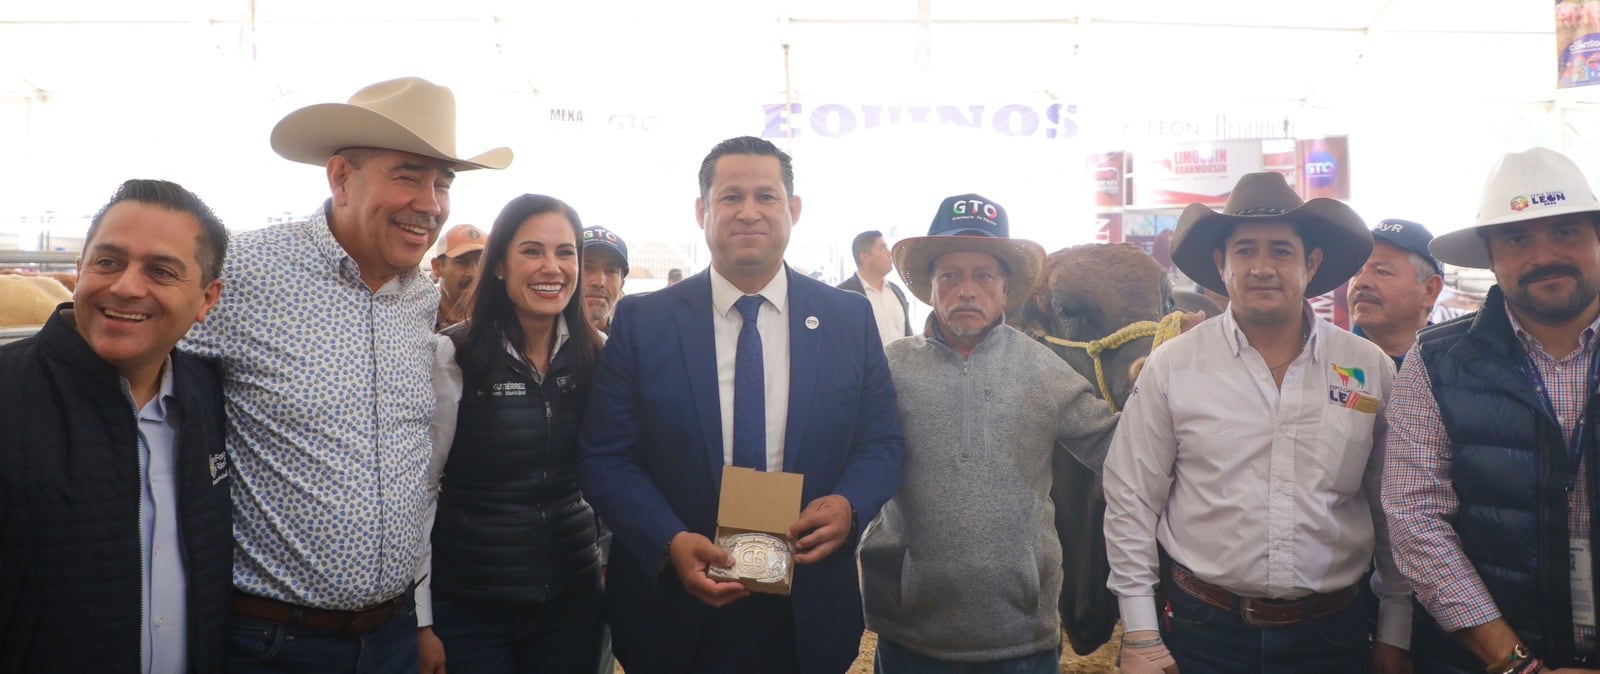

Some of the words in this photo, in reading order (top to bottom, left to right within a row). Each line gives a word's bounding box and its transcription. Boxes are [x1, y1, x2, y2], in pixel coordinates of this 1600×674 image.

[550, 109, 583, 121] MEKA
[953, 200, 998, 219] GTO
[583, 229, 617, 243] GTO
